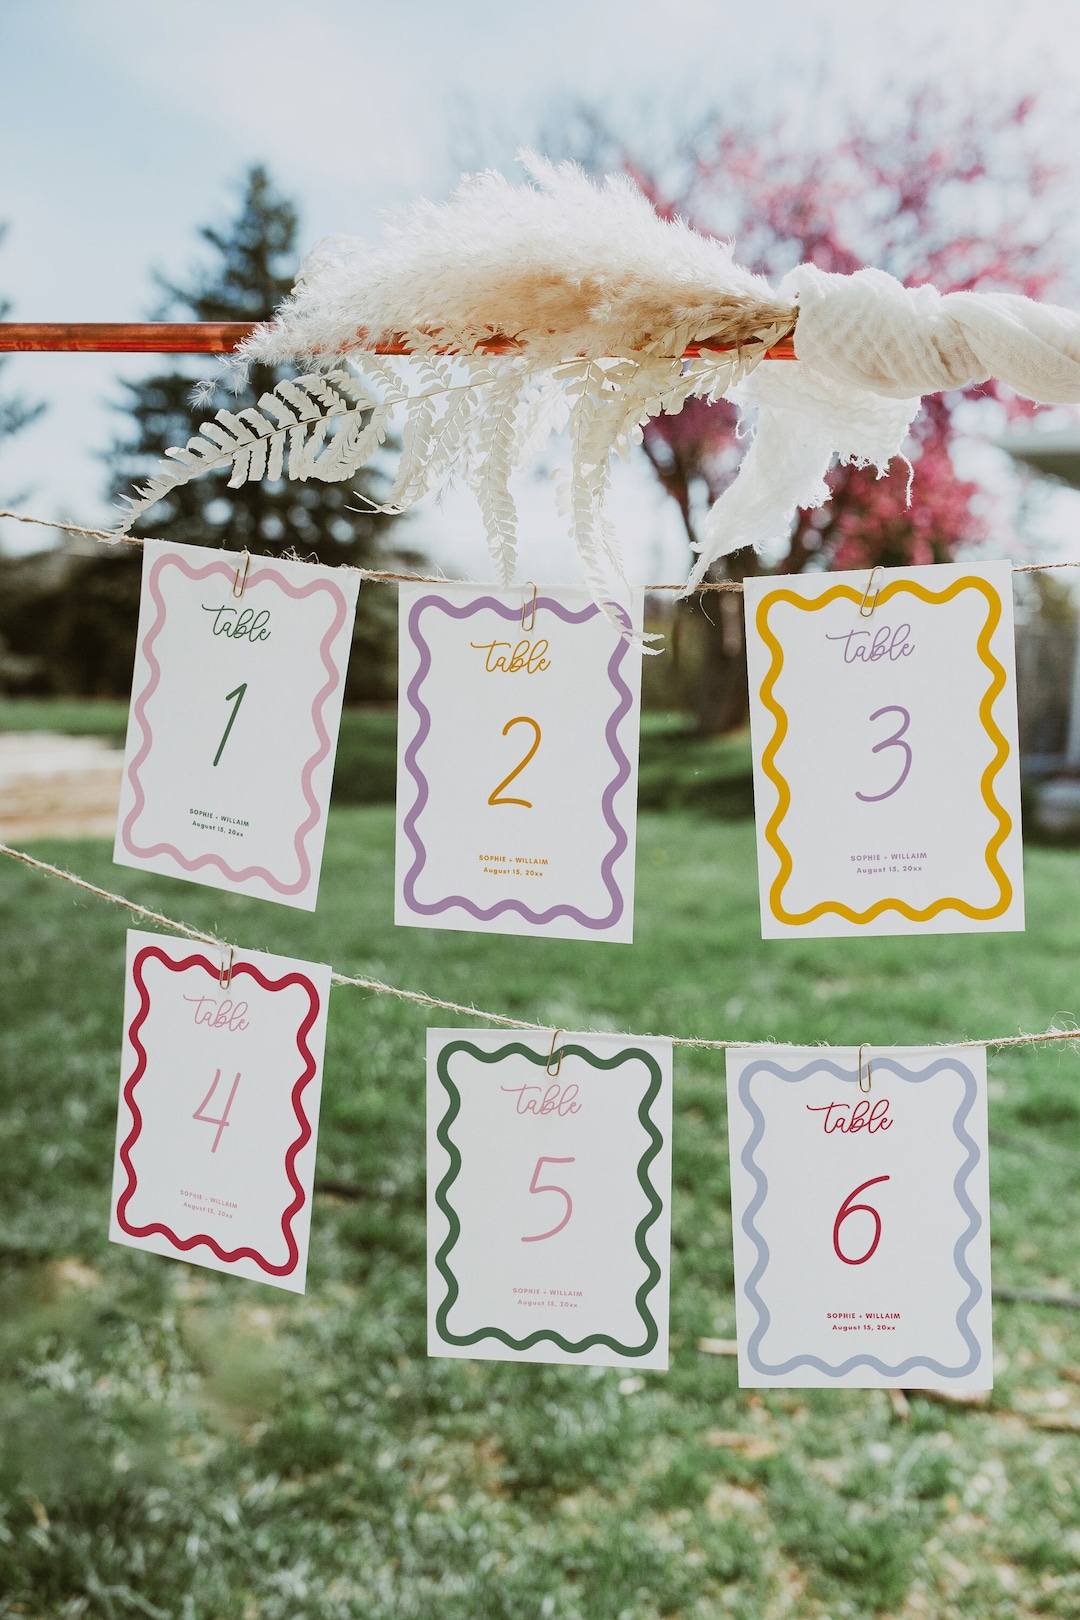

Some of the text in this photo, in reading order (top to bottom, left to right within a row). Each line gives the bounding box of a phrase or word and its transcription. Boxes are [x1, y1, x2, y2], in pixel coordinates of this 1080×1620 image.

[202, 604, 271, 642] table
[470, 639, 551, 675] table
[826, 624, 915, 663] table
[213, 683, 248, 767] 1
[487, 716, 542, 809] 2
[855, 705, 912, 802] 3
[189, 808, 213, 819] SOPHIE
[221, 816, 249, 827] WILLAIM
[192, 820, 216, 829] August
[228, 828, 244, 837] 20xx
[483, 867, 510, 875] August
[183, 995, 249, 1031] table
[193, 1069, 241, 1153] 4
[501, 1084, 582, 1116] table
[806, 1099, 894, 1134] table
[180, 1190, 202, 1200] SOPHIE
[210, 1197, 238, 1209] WILLAIM
[183, 1201, 206, 1212] August
[218, 1210, 232, 1219] 20xx
[521, 1157, 575, 1242] 5
[833, 1175, 890, 1265] 6
